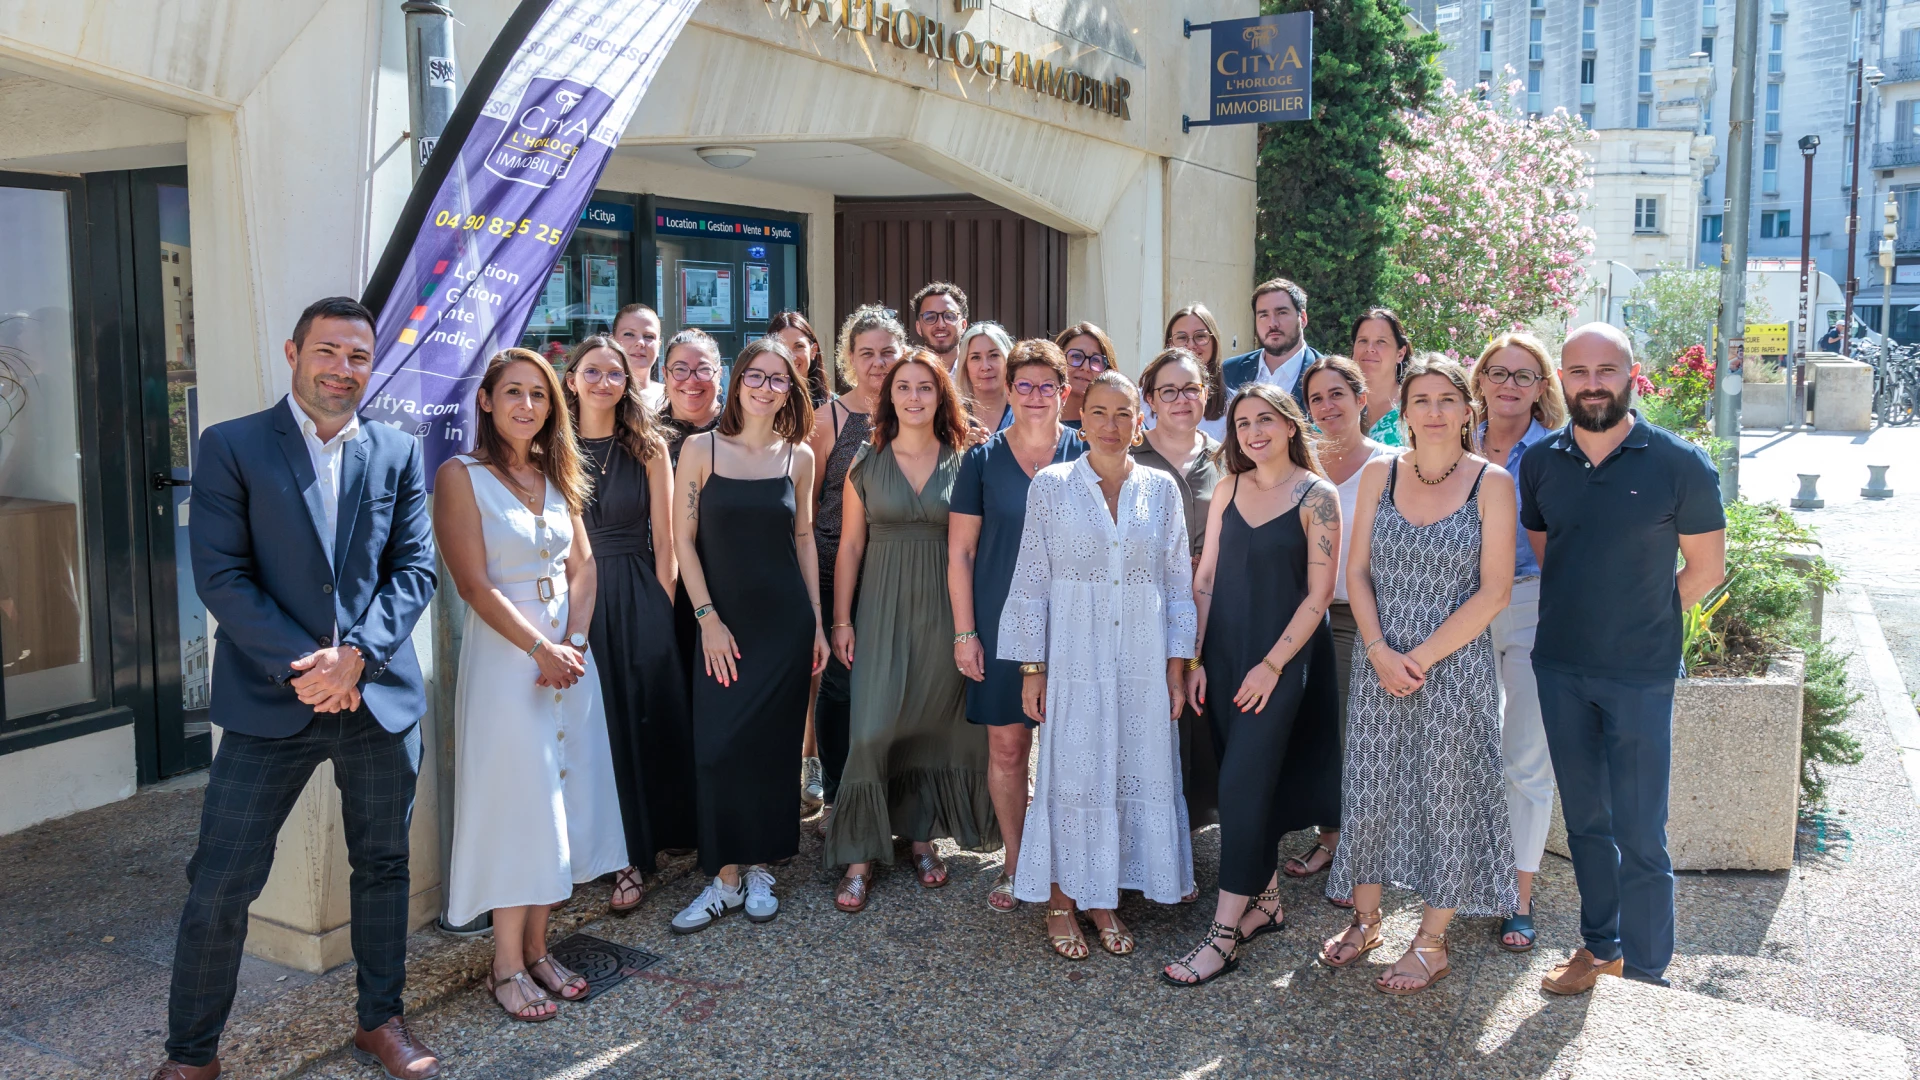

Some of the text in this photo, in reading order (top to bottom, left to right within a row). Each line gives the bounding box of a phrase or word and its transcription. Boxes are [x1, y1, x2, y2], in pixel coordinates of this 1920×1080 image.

[1216, 45, 1303, 76] CITYA
[1226, 75, 1293, 90] L'HORLOGE
[1216, 96, 1303, 116] IMMOBILIER
[496, 151, 565, 177] IMMOBILIE
[435, 210, 461, 229] 04
[462, 215, 486, 230] 90
[534, 224, 563, 245] 25
[588, 209, 616, 225] i-Citya
[666, 217, 792, 239] Location Gestion Vente Syndic
[453, 262, 520, 285] Lotion
